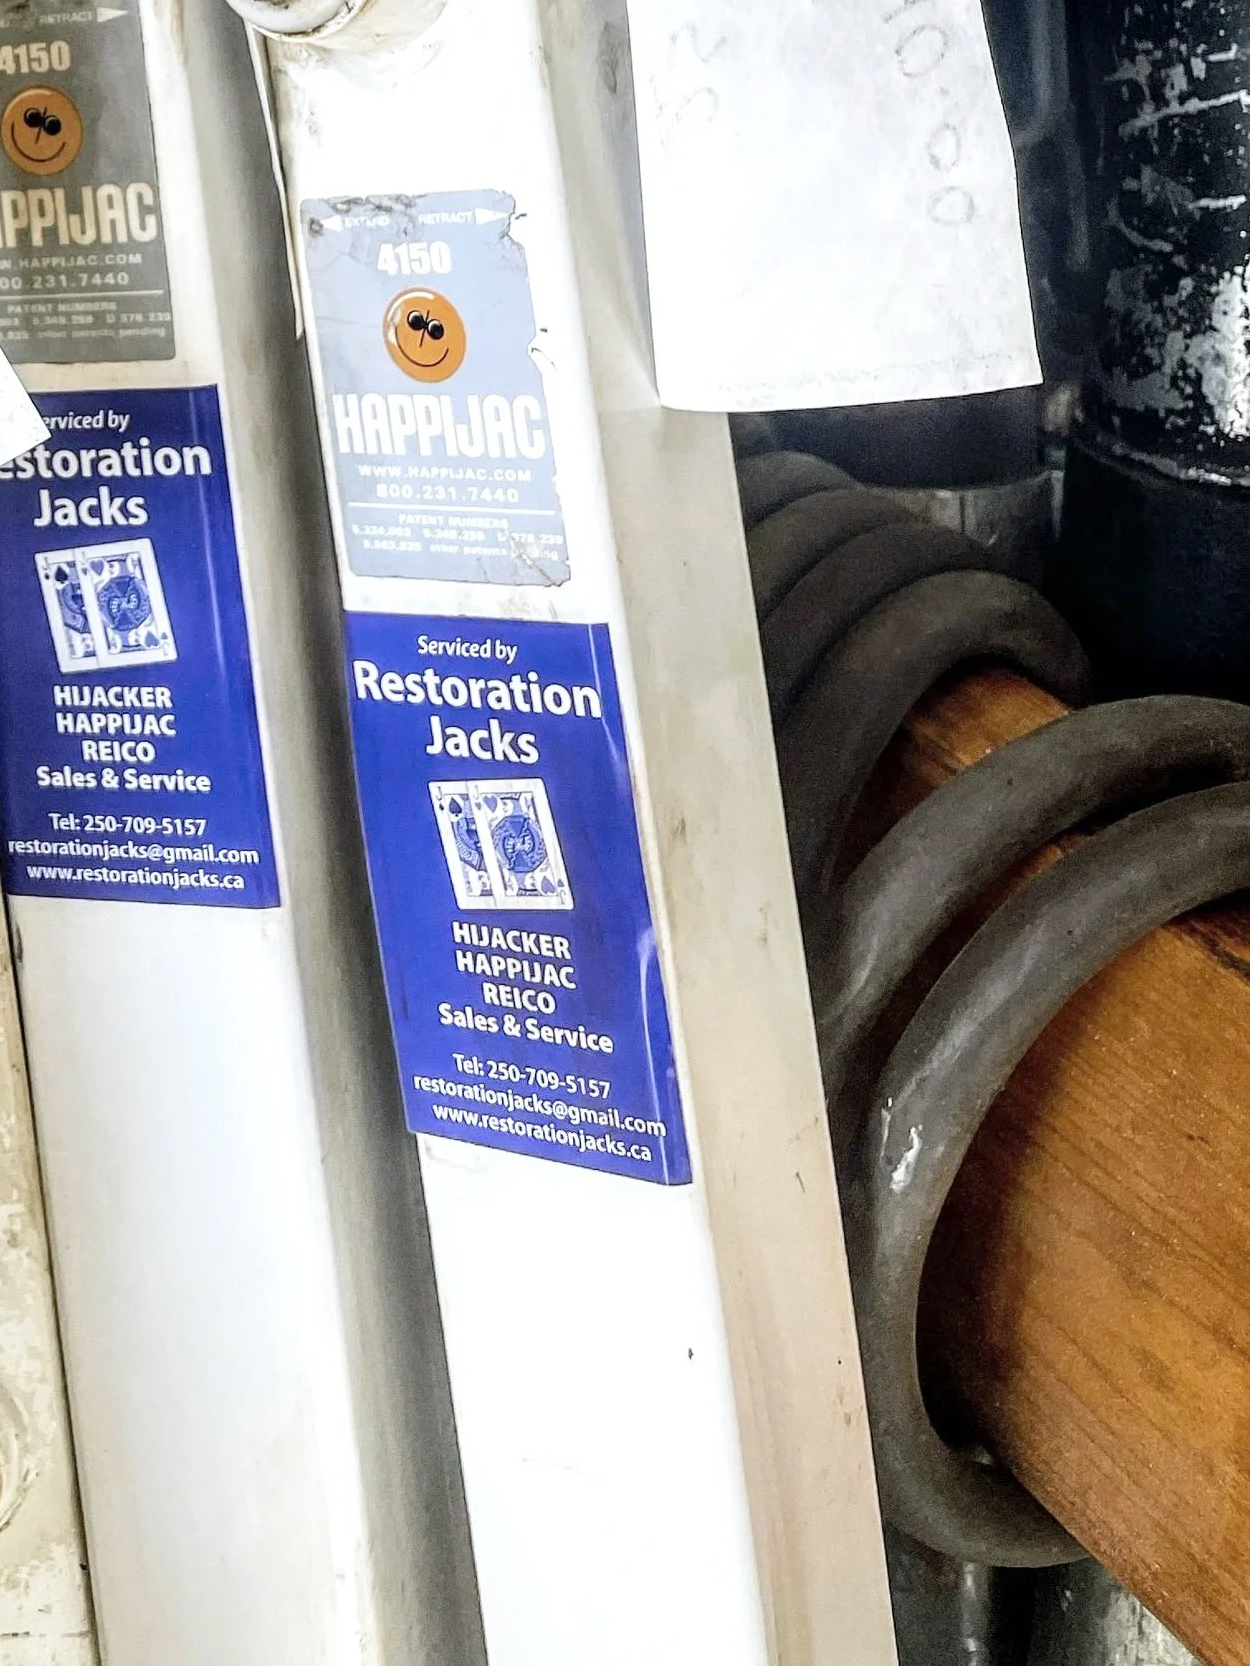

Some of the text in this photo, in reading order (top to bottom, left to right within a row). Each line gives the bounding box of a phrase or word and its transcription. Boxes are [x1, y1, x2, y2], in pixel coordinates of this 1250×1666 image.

[377, 241, 452, 276] 4150
[43, 410, 130, 432] erviced by
[332, 393, 546, 460] HAPPIJAC
[357, 465, 532, 483] WWW.HAPPIJAC.COM
[34, 486, 149, 526] Jacks
[376, 483, 519, 503] 800.231.7440
[417, 635, 518, 665] Serviced by
[53, 685, 173, 708] HIJACKER
[353, 659, 602, 719] Restoration
[56, 712, 177, 736] HAPPIJAC
[426, 715, 540, 764] Jacks
[82, 740, 156, 763] REICO
[36, 766, 211, 793] Sales & Service
[48, 813, 207, 837] Tel: 250-709-5157
[8, 839, 259, 864] restorationjacks@gmail.com
[27, 865, 245, 890] www.restorationjacks.ca
[452, 921, 572, 960] HIJACKER
[454, 950, 577, 989] HAPPIJAC
[482, 982, 556, 1015] REICO
[438, 1002, 614, 1054] Sales & Service
[452, 1053, 611, 1099] Tel: 250-709-5157
[413, 1075, 667, 1137] restorationjacks@gmail.com
[432, 1104, 652, 1161] www.restorationjacks.ca
